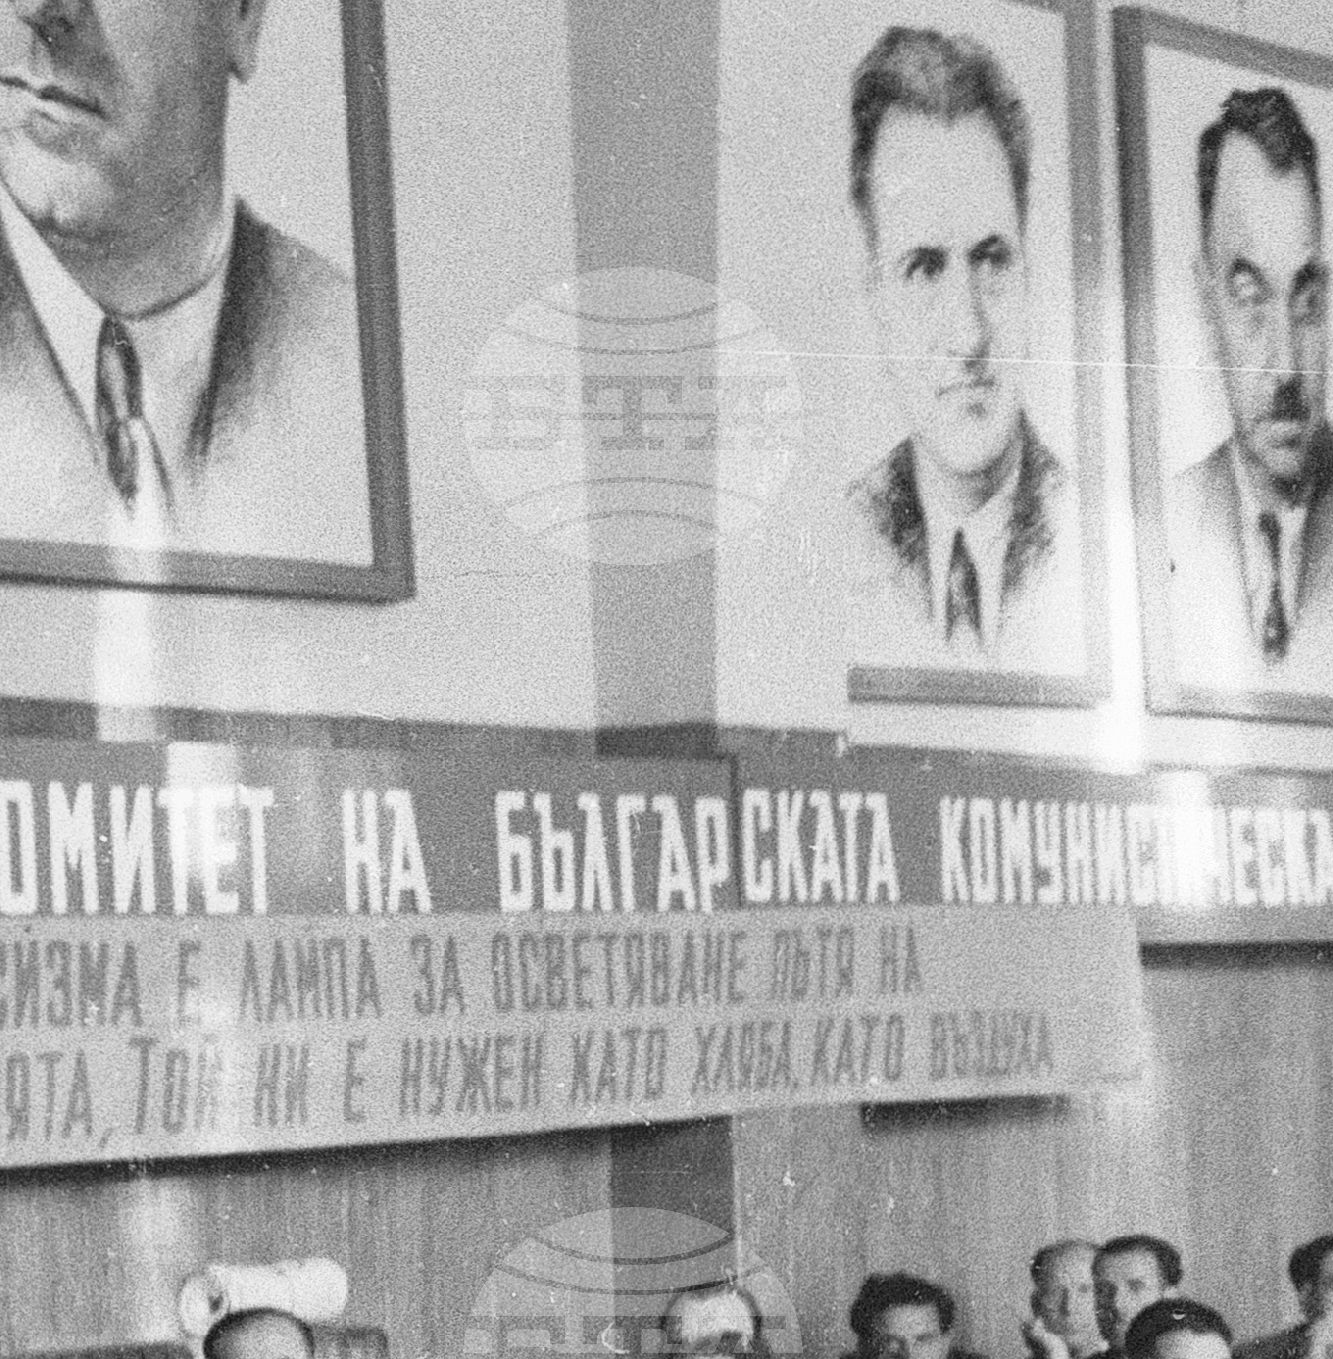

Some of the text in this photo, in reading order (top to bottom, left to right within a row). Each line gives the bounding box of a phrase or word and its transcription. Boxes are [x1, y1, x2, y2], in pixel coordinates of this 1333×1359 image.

[0, 780, 274, 914] ОМИТЕТ
[341, 789, 433, 914] НА
[495, 788, 902, 912] БЪЛГАРСКАТА
[0, 938, 144, 1031] ИЗМА
[240, 935, 382, 1022] ЛАМПА
[410, 932, 466, 1017] ЗА
[491, 929, 748, 1012] ОСВЕТЯВАНЕ
[771, 926, 856, 1002] ПЪТЯ
[879, 920, 923, 995] НА
[252, 1042, 310, 1130] НИ
[344, 1036, 367, 1124] Е
[401, 1033, 545, 1116] НУЖЕН
[570, 1026, 668, 1103] КАТО
[811, 1014, 905, 1087] КАТО
